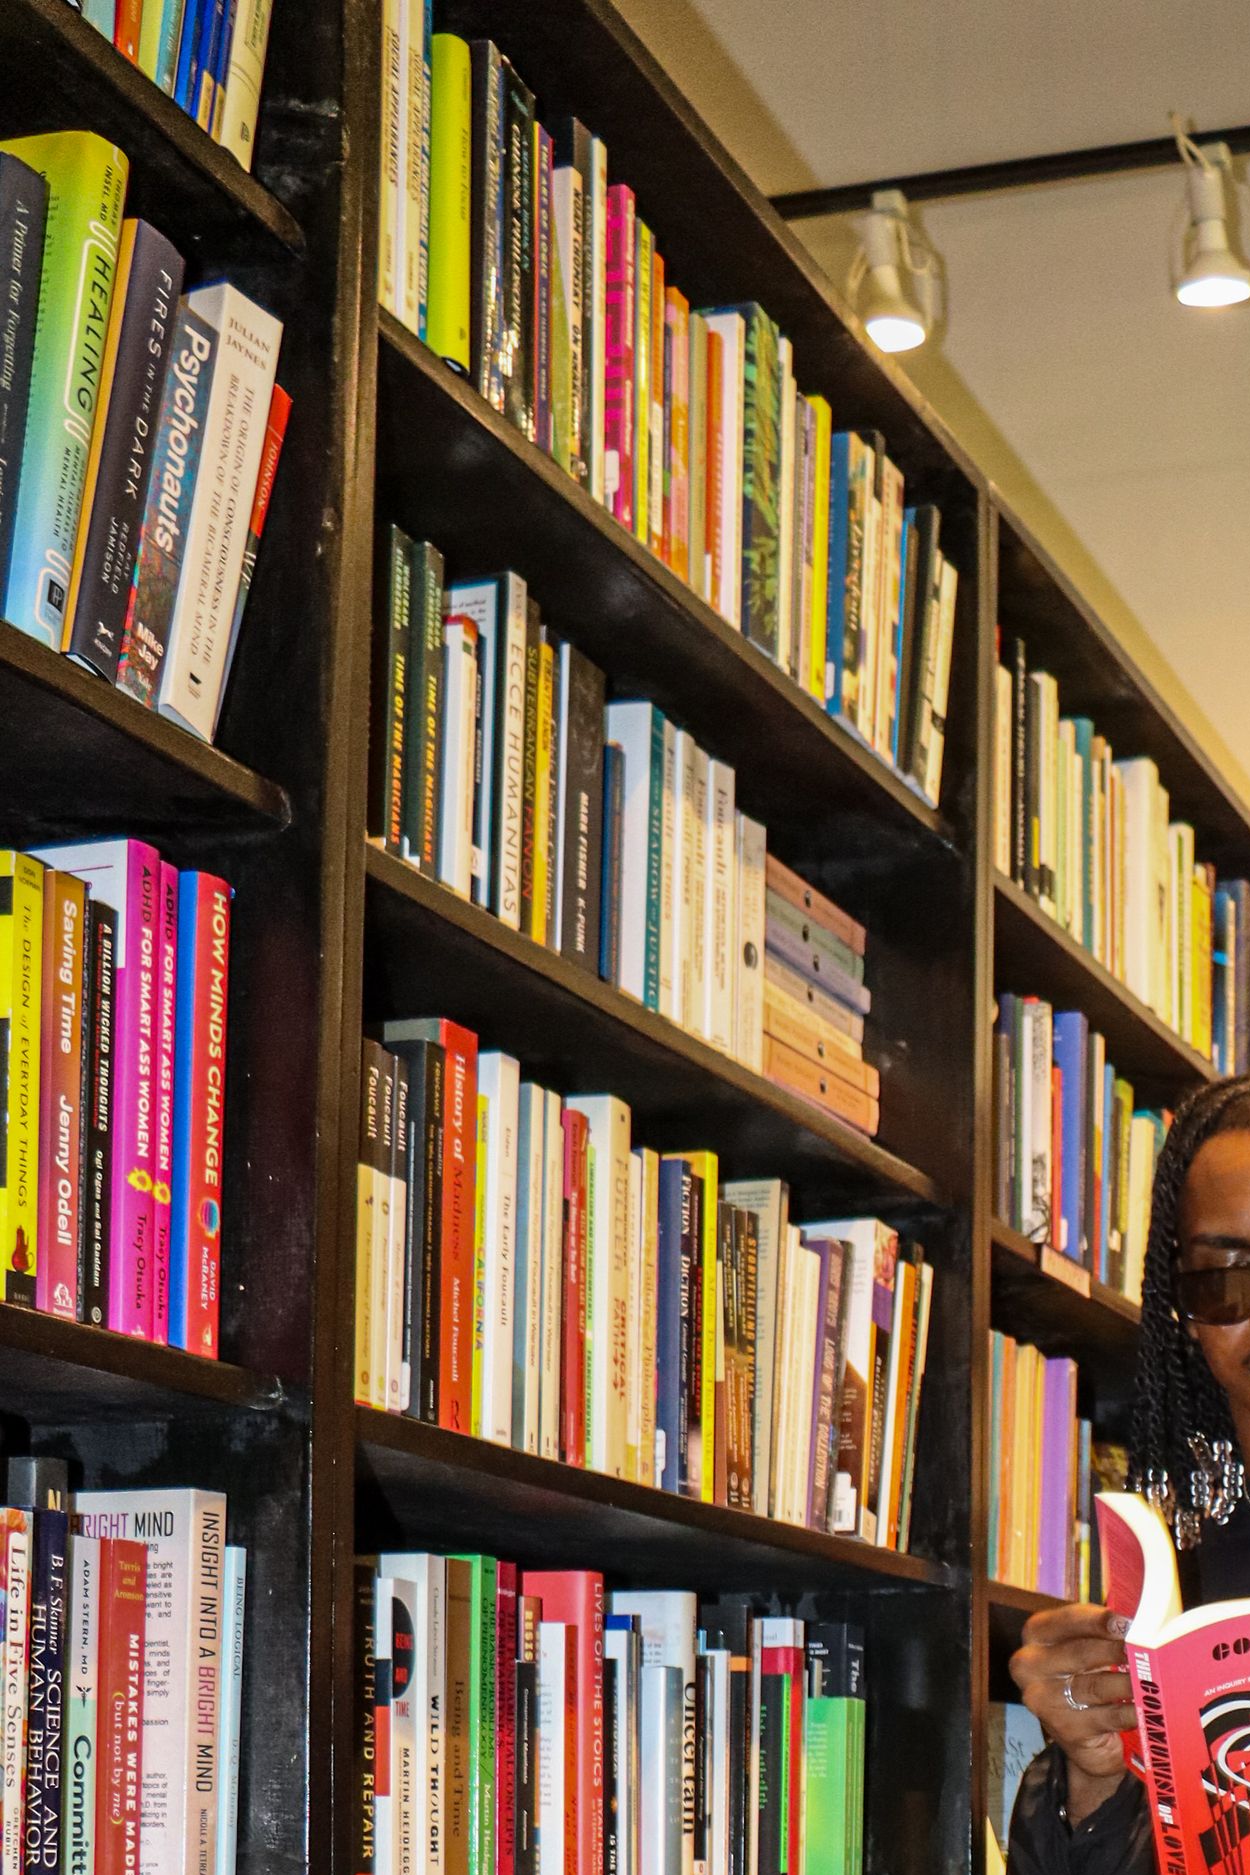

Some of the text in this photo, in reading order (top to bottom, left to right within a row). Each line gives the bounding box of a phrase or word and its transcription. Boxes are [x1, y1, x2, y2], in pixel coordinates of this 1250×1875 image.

[100, 165, 113, 221] INSEL MD
[2, 200, 29, 391] A Primer for Forgetting
[77, 255, 111, 413] HEALING
[226, 335, 266, 371] JAYNES
[229, 318, 271, 354] JULIAN
[124, 270, 172, 501] FIRES IN THE DARK
[154, 324, 211, 553] Psychonauts
[101, 516, 119, 583] JAMISON
[190, 374, 239, 656] BREAKDOWN OF THE BICAMERAL MIND
[202, 388, 255, 664] THE ORIGIN OF CONSCIOUSNESS IN THE
[257, 441, 279, 511] JOHNSON
[111, 522, 129, 595] REDFIELD
[137, 622, 165, 656] Mike
[138, 649, 159, 671] Jay
[503, 643, 523, 913] ECCE HUMANITAS
[521, 647, 538, 901] SUBTERRANEAN FANON
[576, 792, 589, 953] MARK FISHER K-PUNK
[16, 903, 33, 1208] The DESIGN of EVERYDAY THINGS
[53, 898, 78, 1245] Saving Time Jenny Odell
[98, 924, 112, 1133] A BILLION WICKED THOUGHTS
[136, 866, 154, 1158] ADHD FOR SMART ASS WOMEN
[204, 892, 228, 1188] HOW MINDS CHANGE
[366, 1066, 381, 1139] Foucault
[451, 1054, 467, 1263] History of Madness
[133, 1213, 148, 1311] Tracy Otsuka
[450, 1277, 462, 1384] Michel Foucault
[4, 1546, 27, 1788] Life in Five Senses
[48, 1554, 63, 1655] B. F. Skinner
[195, 1511, 220, 1793] INSIGHT INTO A BRIGHT MIND
[1134, 1652, 1153, 1681] THE
[25, 1603, 48, 1868] HUMAN BEHAVIOR
[110, 1691, 126, 1826] (but not by me)
[126, 1634, 141, 1743] MISTAKES
[362, 1625, 376, 1859] TRUTH AND REPAIR
[1140, 1679, 1177, 1808] COMMUNISM
[1204, 1688, 1216, 1697] AN
[1217, 1678, 1246, 1693] INQUIRY
[43, 1669, 61, 1869] SCIENCE AND
[125, 1751, 139, 1815] WERE
[402, 1747, 411, 1803] MARTIN
[429, 1695, 440, 1867] WILD THOUGHT
[1157, 1803, 1174, 1825] OF
